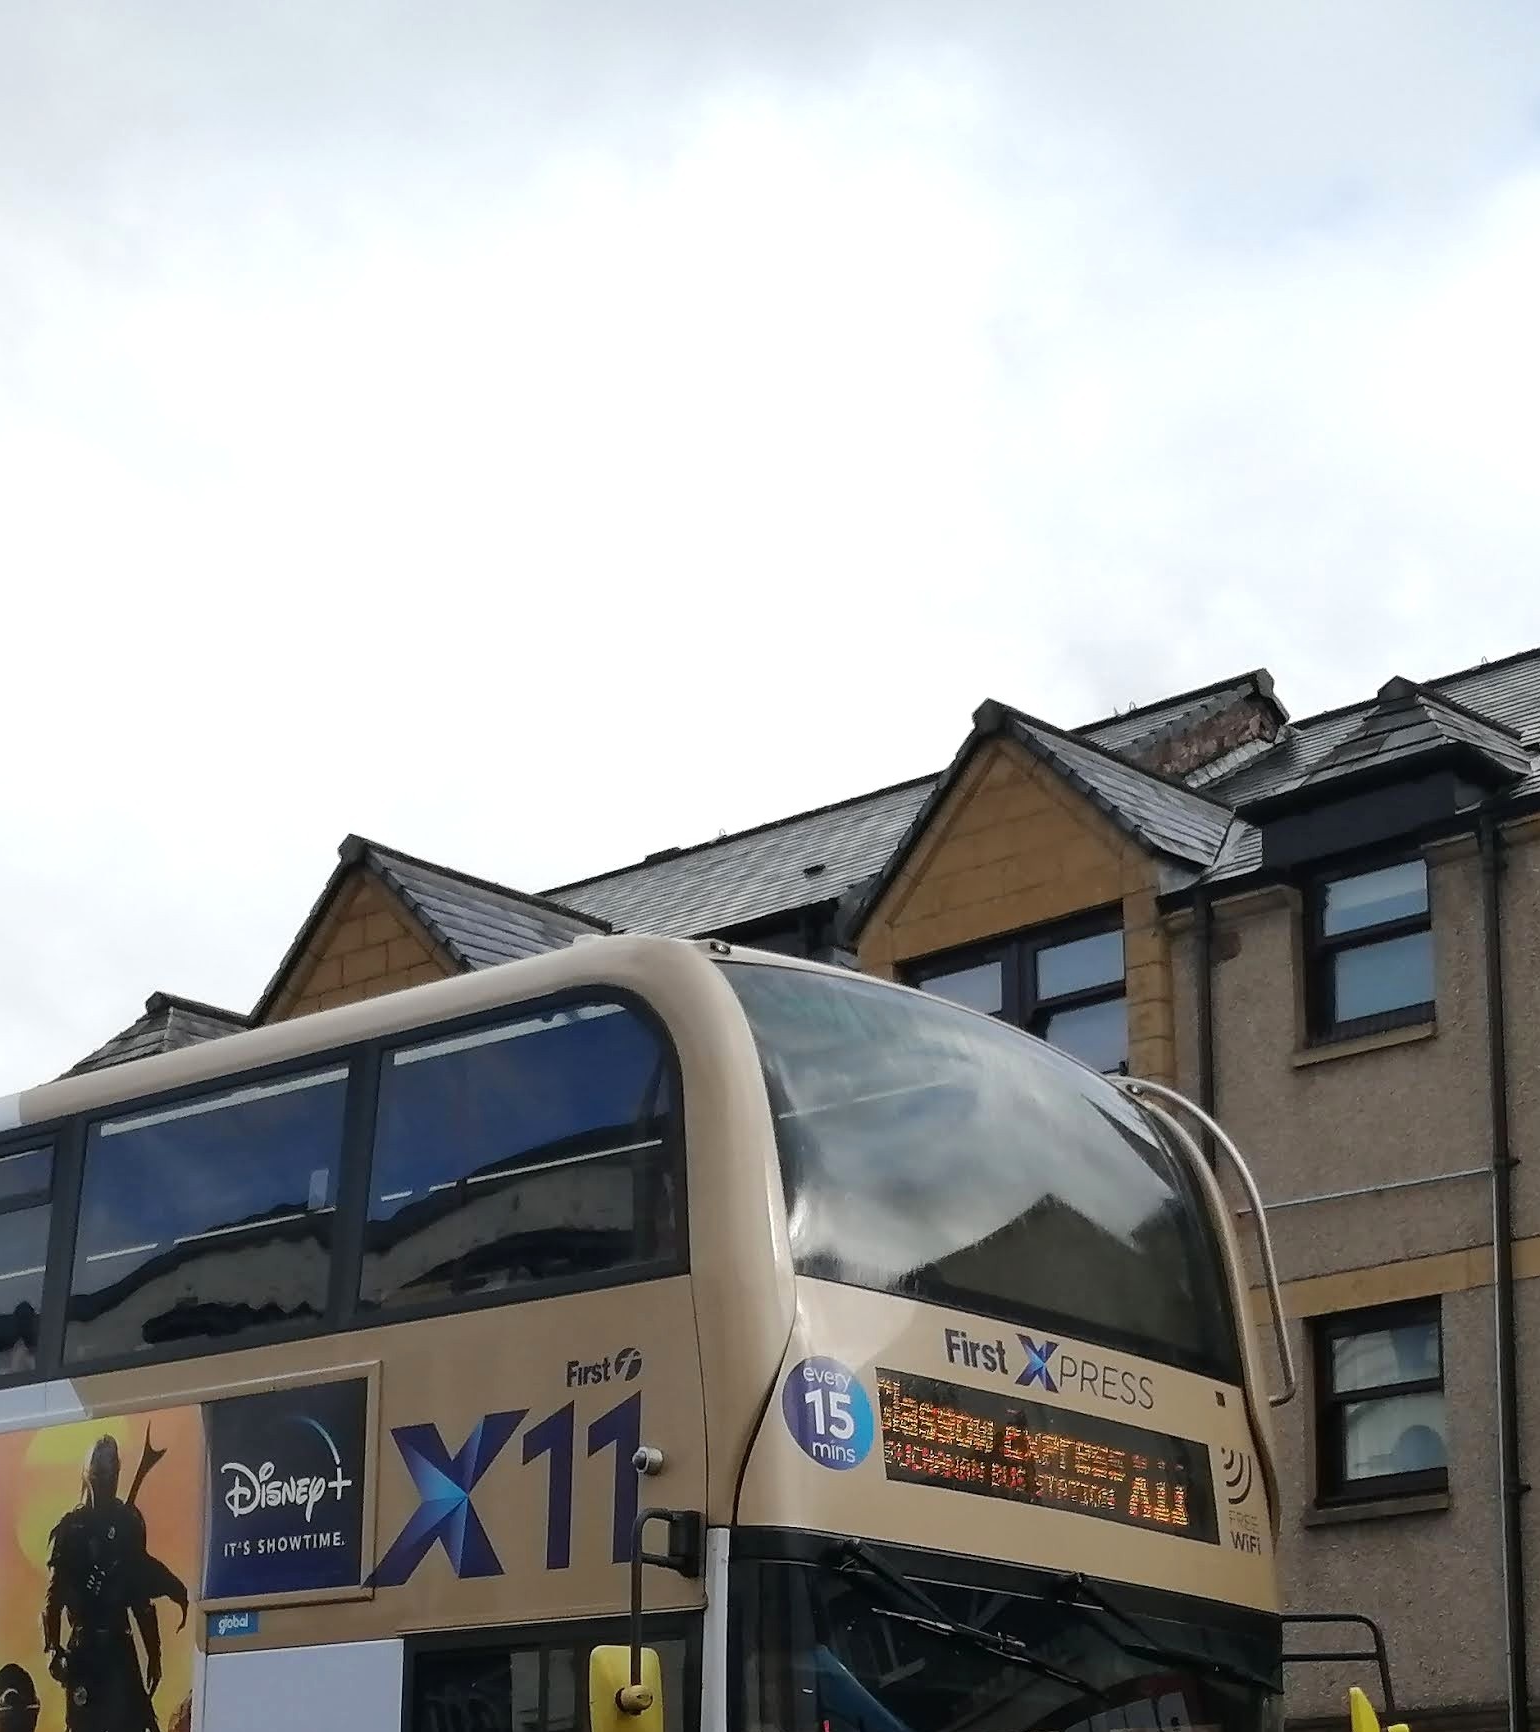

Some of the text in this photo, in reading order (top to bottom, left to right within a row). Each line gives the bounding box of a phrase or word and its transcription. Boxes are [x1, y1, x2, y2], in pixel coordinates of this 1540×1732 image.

[566, 1357, 611, 1388] First
[802, 1367, 852, 1393] every
[945, 1327, 1154, 1410] First XPRESS
[804, 1388, 855, 1440] 15
[812, 1440, 856, 1464] mins
[220, 1457, 352, 1522] Disney+
[362, 1390, 642, 1587] X11
[224, 1541, 251, 1556] IT'S
[218, 1613, 249, 1635] global
